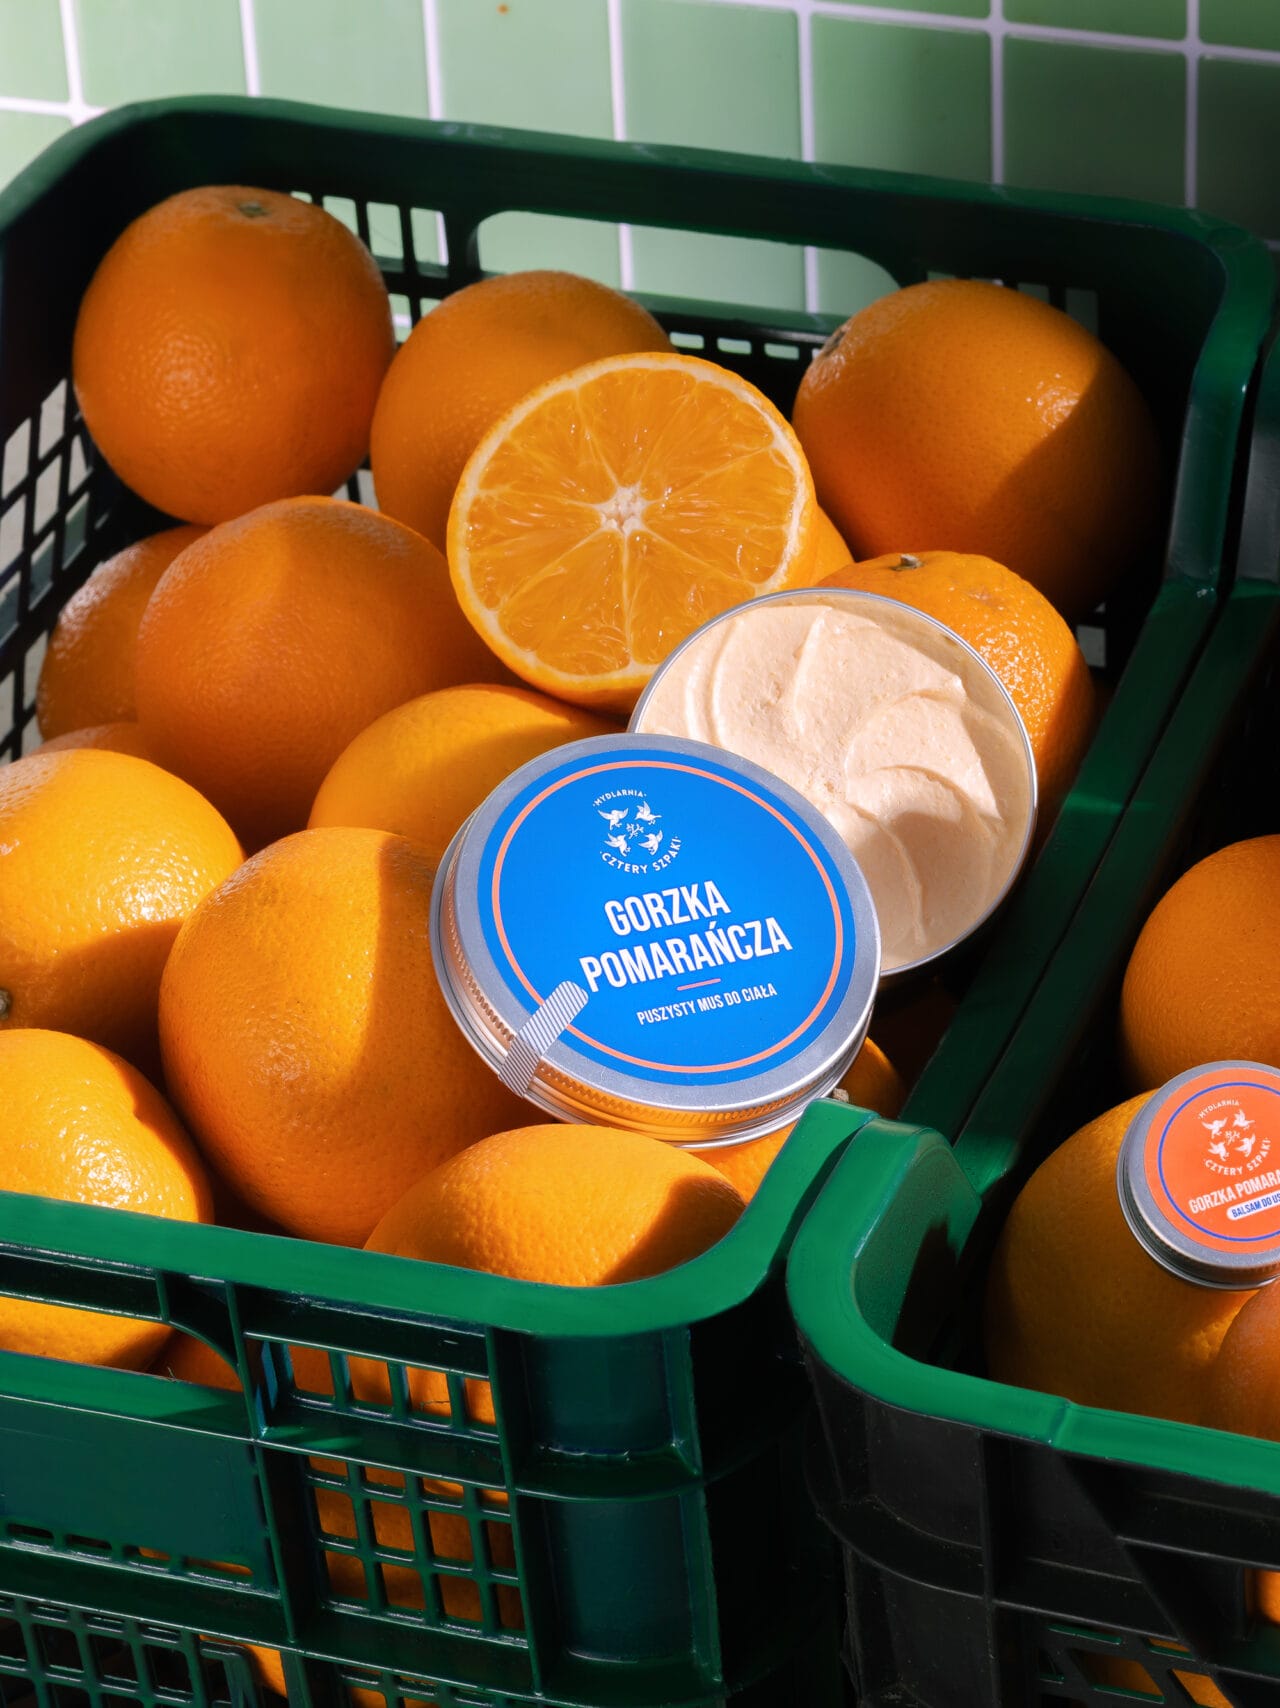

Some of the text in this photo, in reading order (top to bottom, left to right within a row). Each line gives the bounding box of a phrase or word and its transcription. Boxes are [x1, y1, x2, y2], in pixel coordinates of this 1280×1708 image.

[601, 838, 682, 874] CZTERY SZPAKI
[604, 880, 732, 936] GORZKA
[579, 916, 793, 993] POMARAŃCZA
[636, 982, 778, 1026] PUSZYSTY MUS DO CIAŁA
[1188, 1186, 1237, 1214] GORZKA
[1231, 1200, 1263, 1218] BALSAM
[1261, 1196, 1273, 1208] DO
